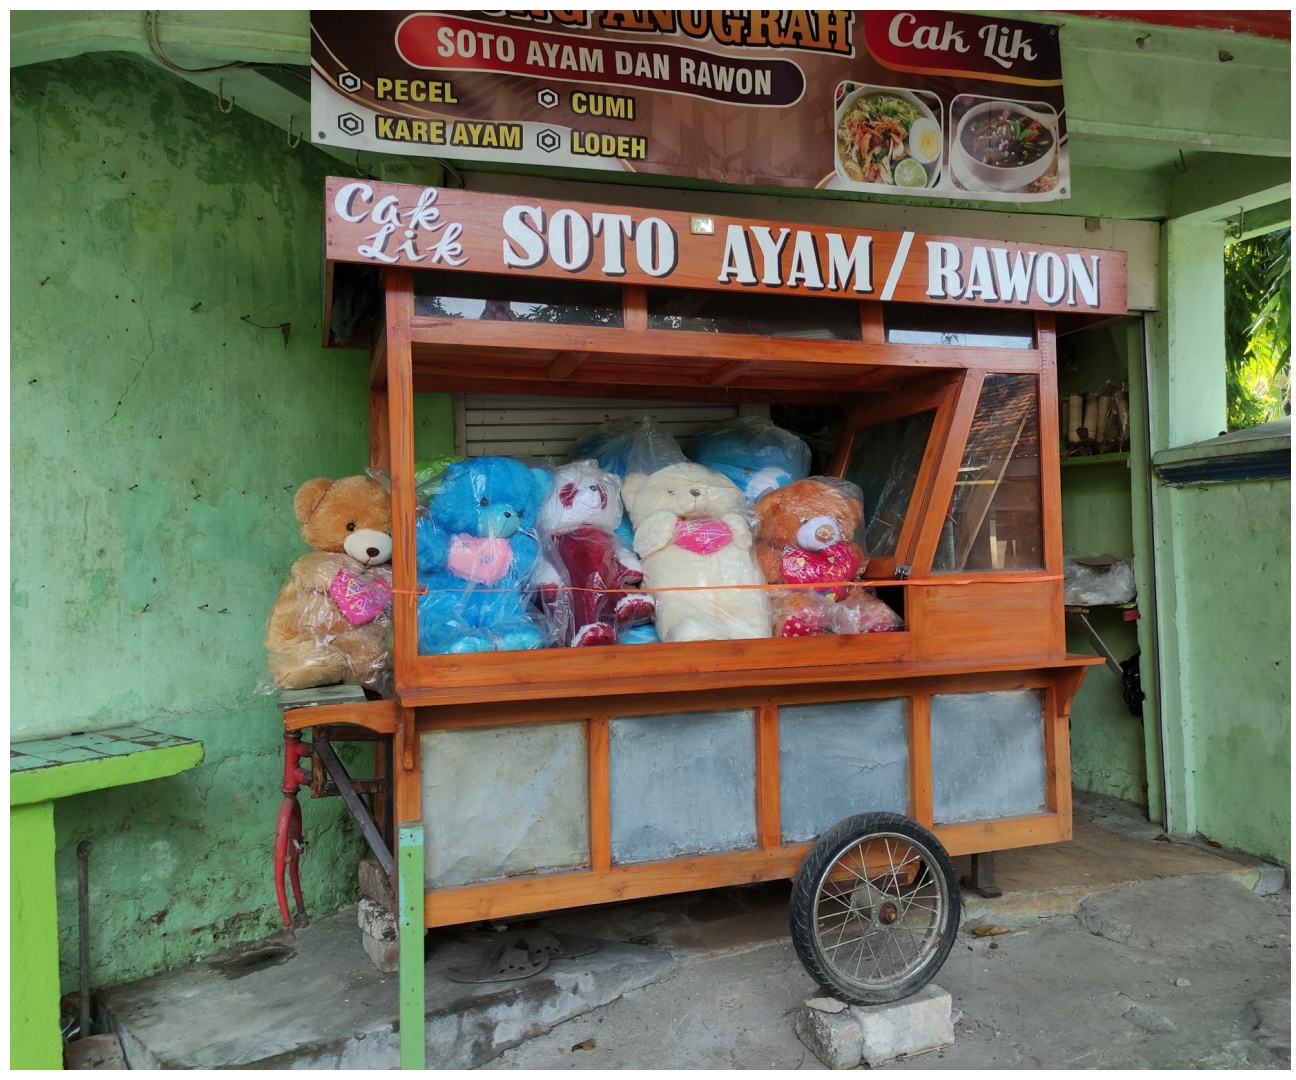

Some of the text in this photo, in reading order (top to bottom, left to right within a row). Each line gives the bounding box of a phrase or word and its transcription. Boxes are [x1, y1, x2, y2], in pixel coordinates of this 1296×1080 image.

[436, 26, 772, 96] SOTO AYAM DAN RAWON
[887, 12, 1038, 69] Cak Lik
[376, 77, 458, 104] PECEL
[571, 92, 635, 120] CUMI
[376, 117, 522, 149] KARE AYAM
[572, 131, 647, 160] LODEH
[334, 183, 449, 231] Cak
[357, 222, 470, 266] Lik
[502, 205, 678, 278] SOTO
[717, 224, 874, 294] AYAM
[925, 241, 1101, 309] RAWON
